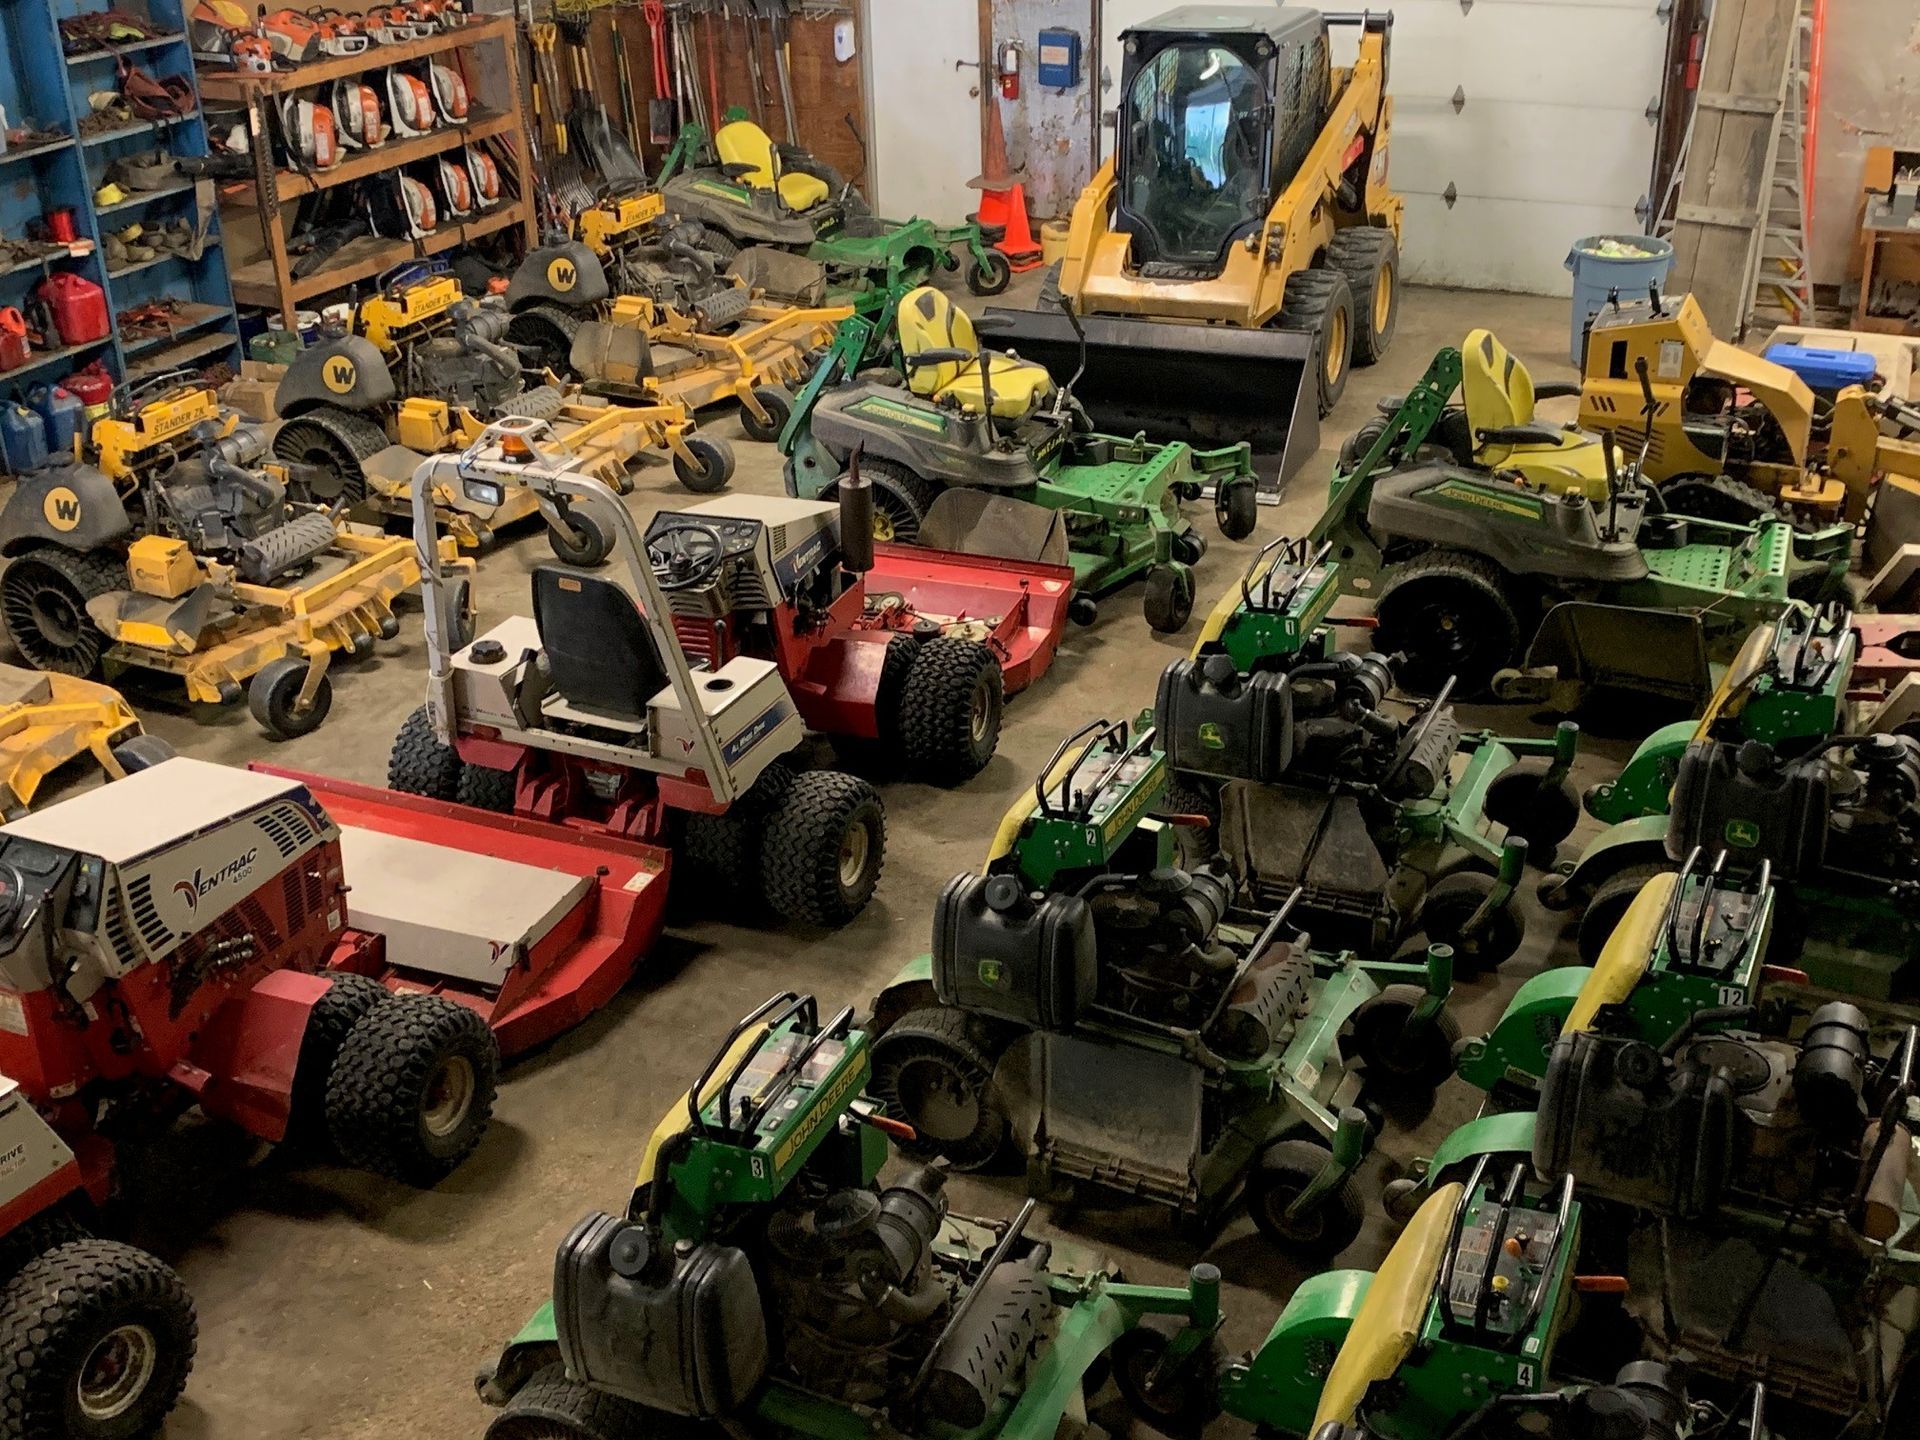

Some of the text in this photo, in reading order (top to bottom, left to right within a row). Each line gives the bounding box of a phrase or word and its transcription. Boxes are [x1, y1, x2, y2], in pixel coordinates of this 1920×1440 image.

[557, 266, 575, 284] W
[333, 365, 354, 384] W
[154, 412, 191, 436] STANDER
[194, 405, 206, 418] ZK
[55, 498, 79, 521] W
[1087, 830, 1095, 845] 2
[173, 847, 258, 918] VENTRAC
[233, 866, 252, 884] 4500
[1722, 988, 1742, 1006] 12
[789, 1065, 857, 1154] JOHN DEERE
[0, 1144, 24, 1165] RIVE
[753, 1158, 762, 1177] 3
[1520, 1366, 1530, 1386] 4
